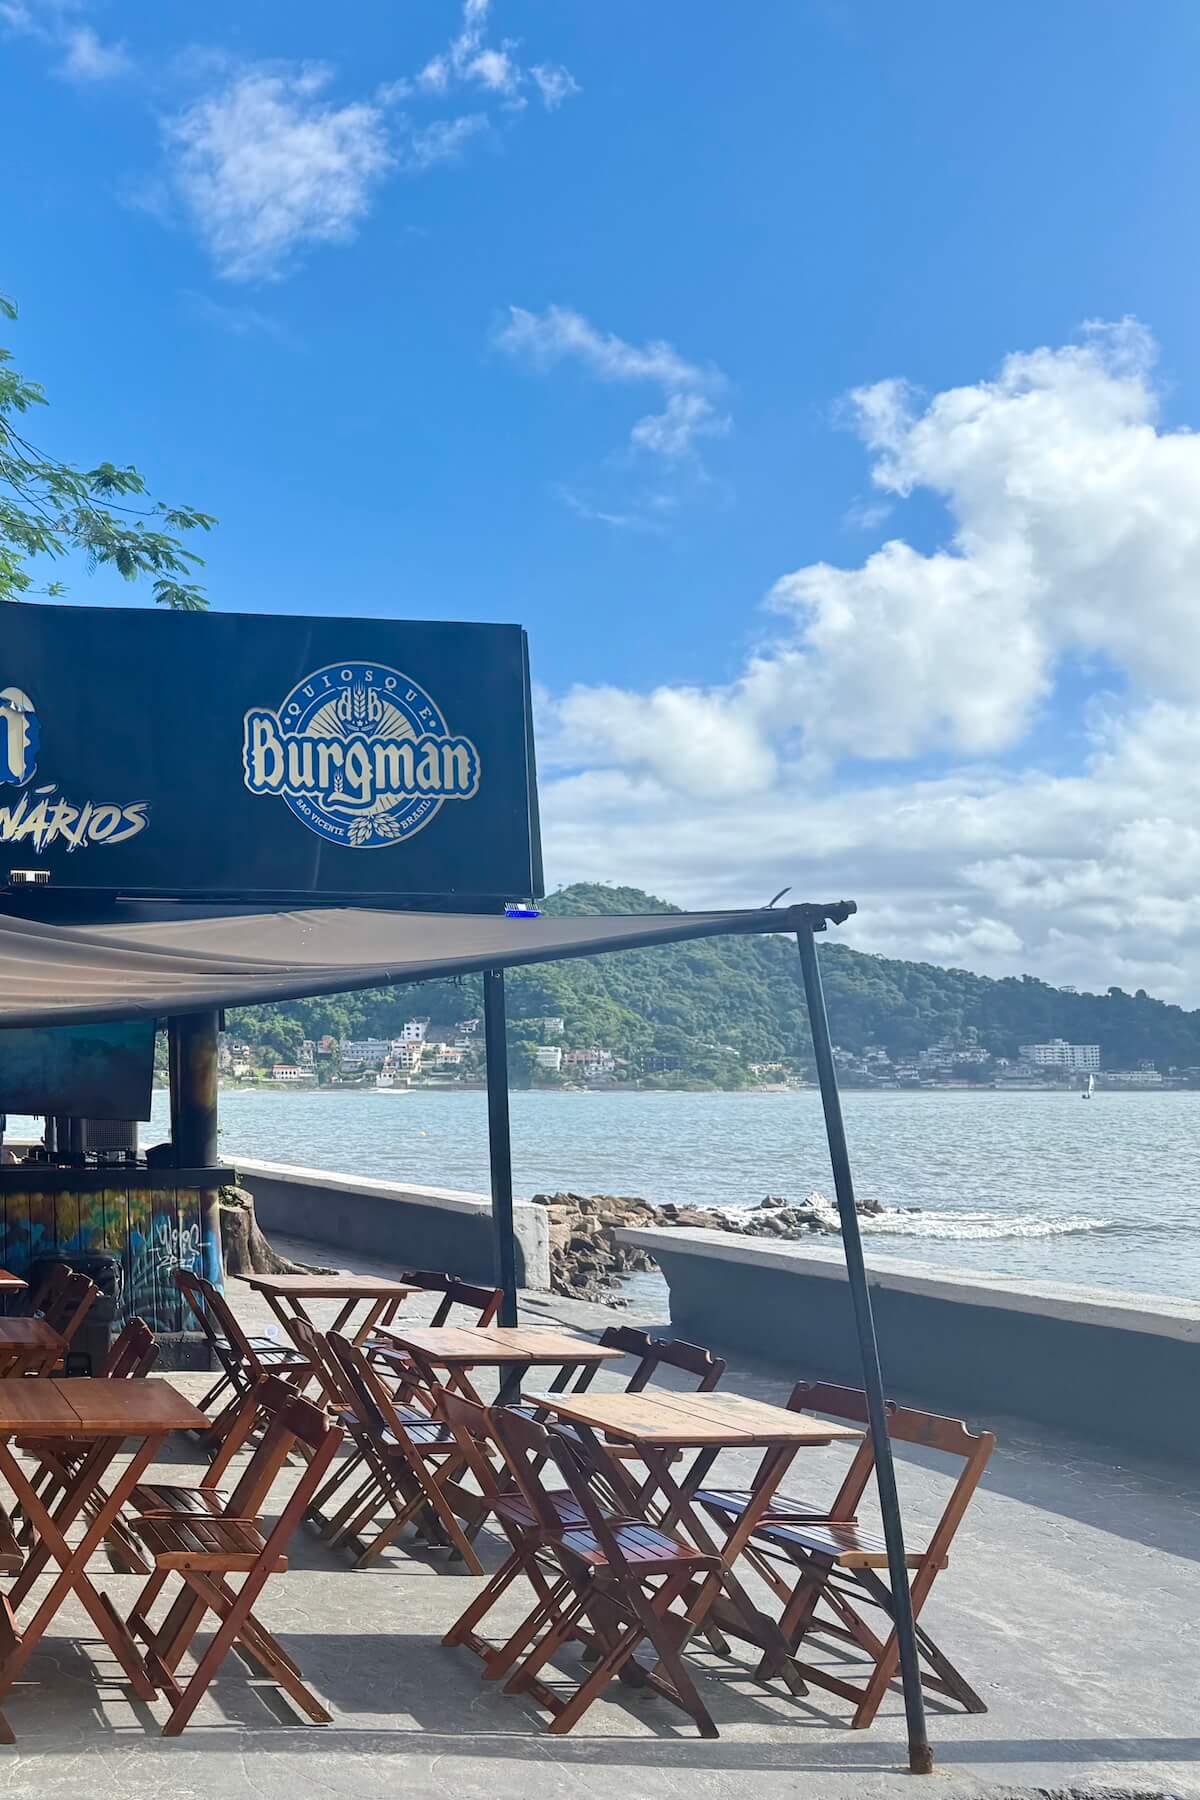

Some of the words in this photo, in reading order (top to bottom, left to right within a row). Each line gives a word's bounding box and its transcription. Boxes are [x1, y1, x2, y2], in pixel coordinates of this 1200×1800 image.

[287, 669, 433, 720] QUIOSQUE
[252, 717, 472, 805] Burgman
[310, 811, 345, 836] VICENTE
[401, 800, 432, 830] BRASIL
